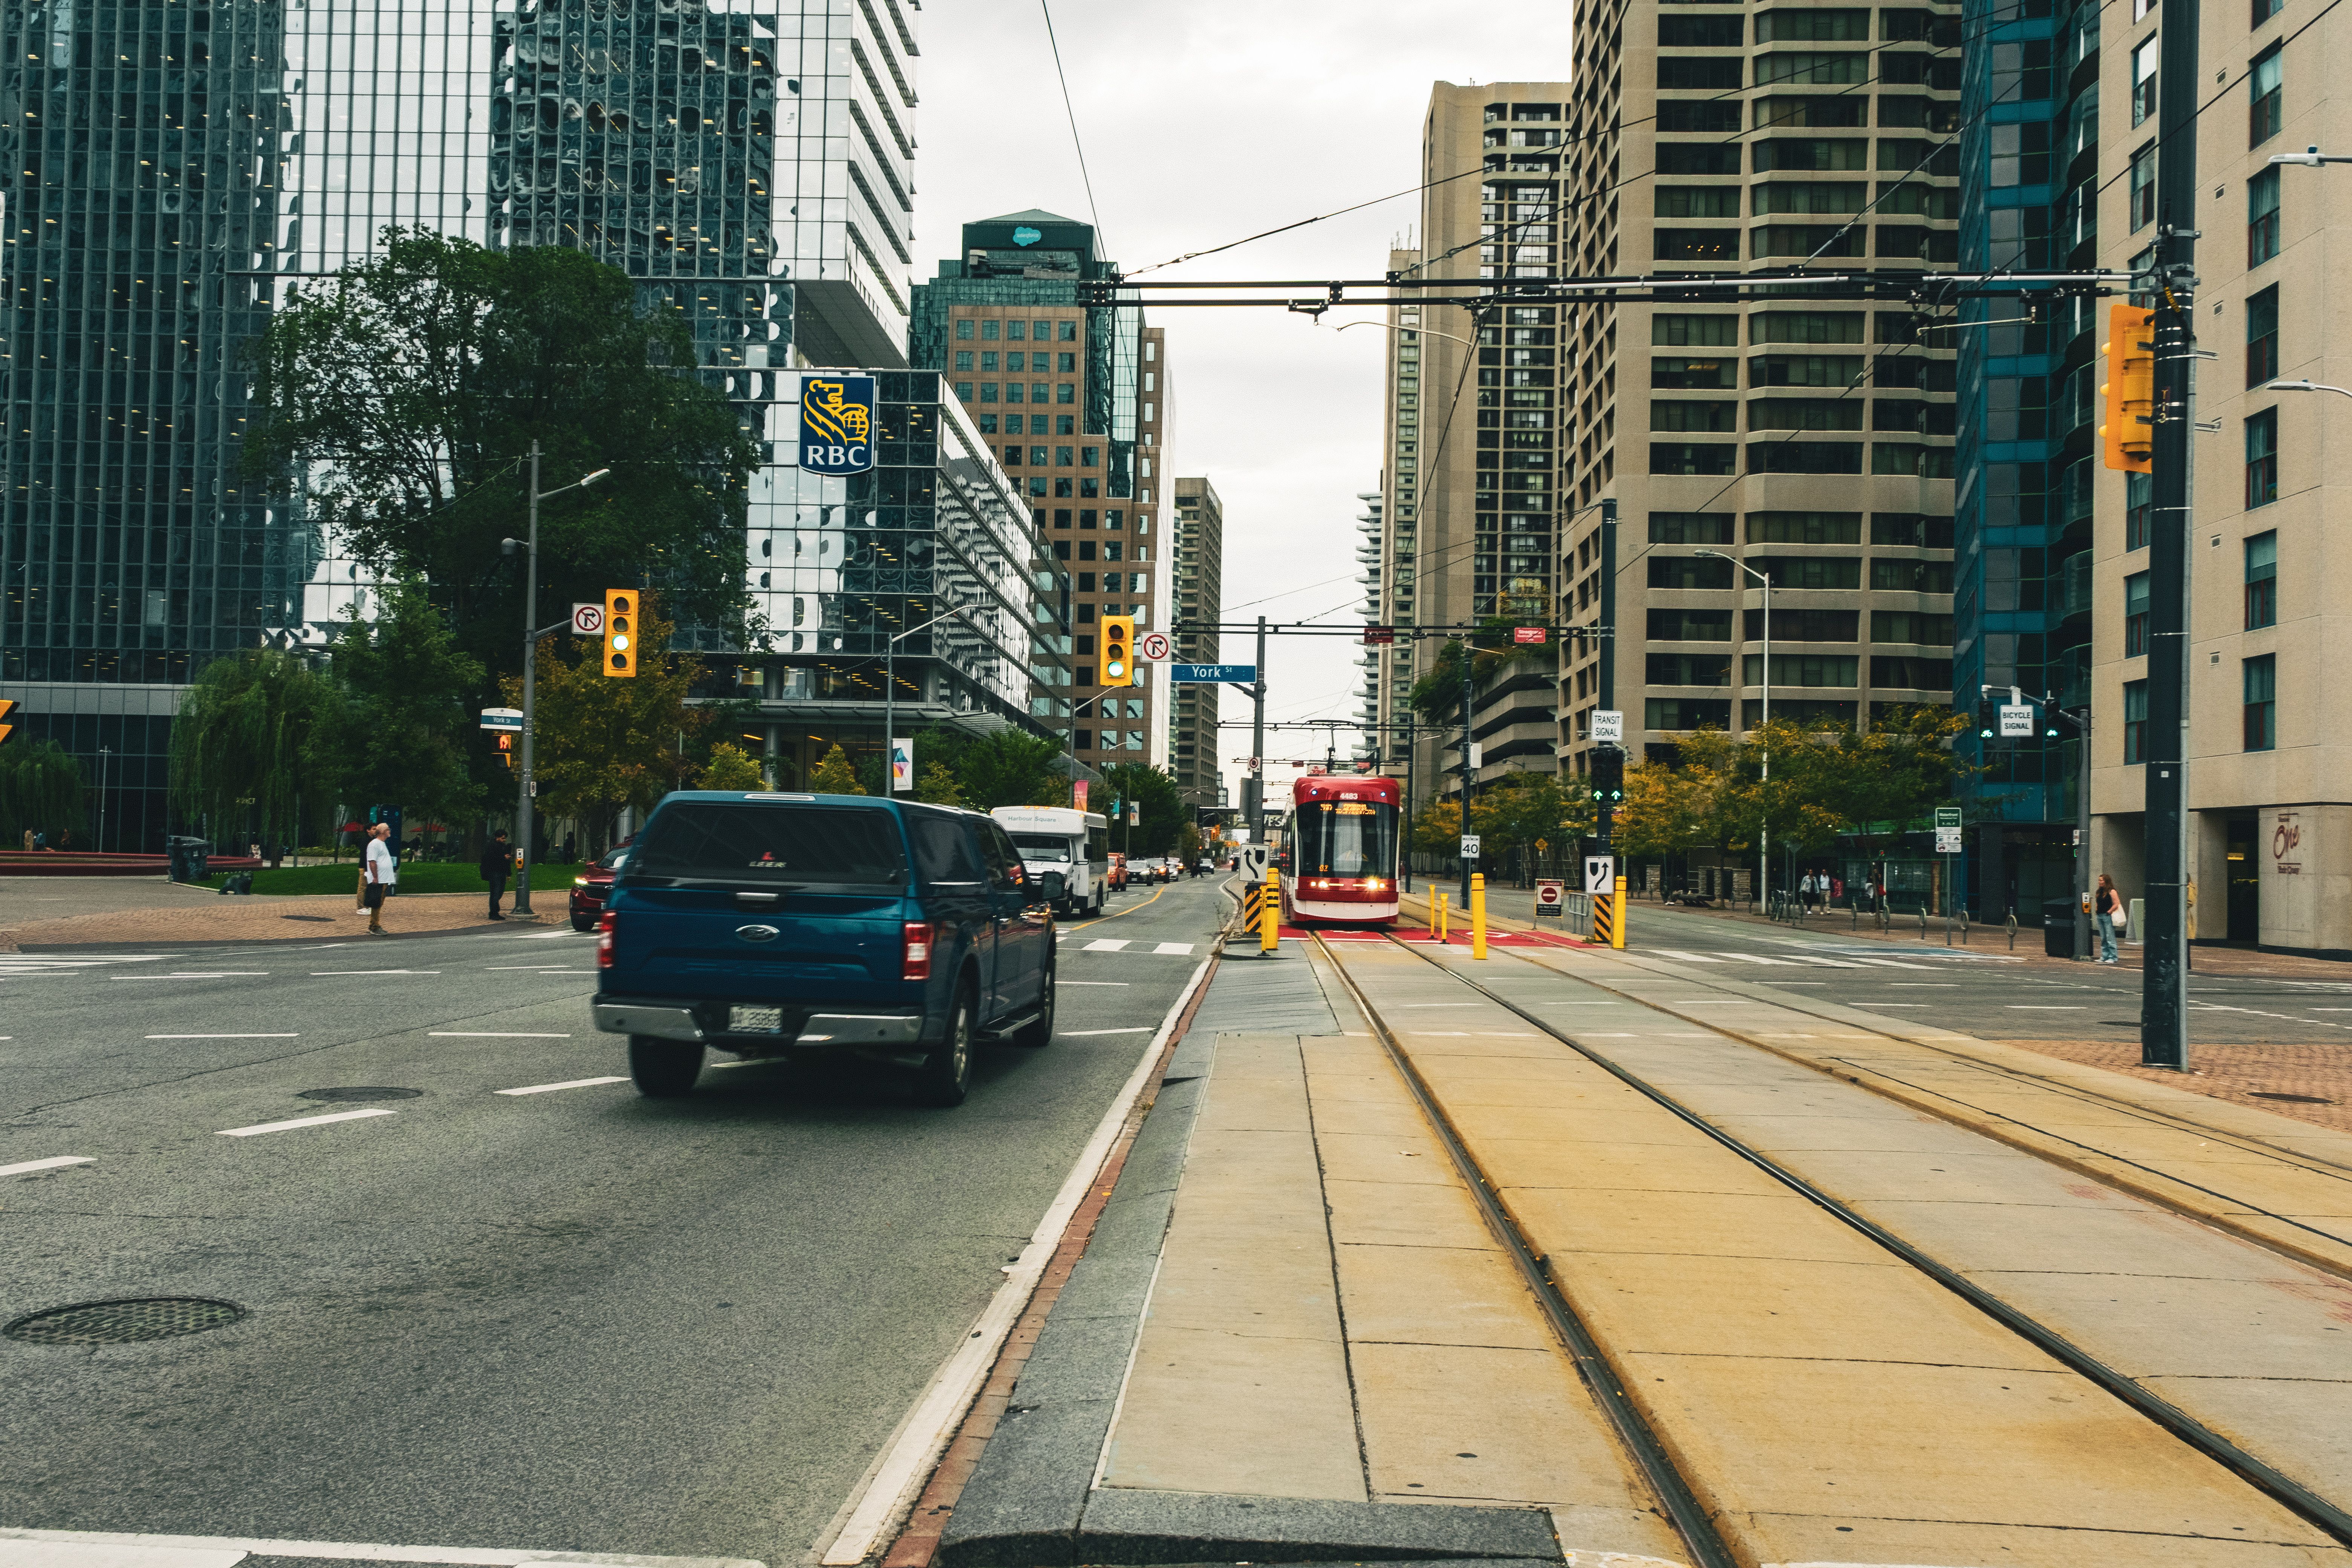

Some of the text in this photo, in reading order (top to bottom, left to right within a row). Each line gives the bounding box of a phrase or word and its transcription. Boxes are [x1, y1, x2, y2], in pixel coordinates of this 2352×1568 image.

[807, 445, 865, 466] RBC
[1192, 666, 1221, 678] York
[1594, 715, 1620, 724] TRANSIT
[1596, 727, 1618, 737] SIGNAL
[2273, 824, 2300, 859] One
[1462, 844, 1478, 854] 40
